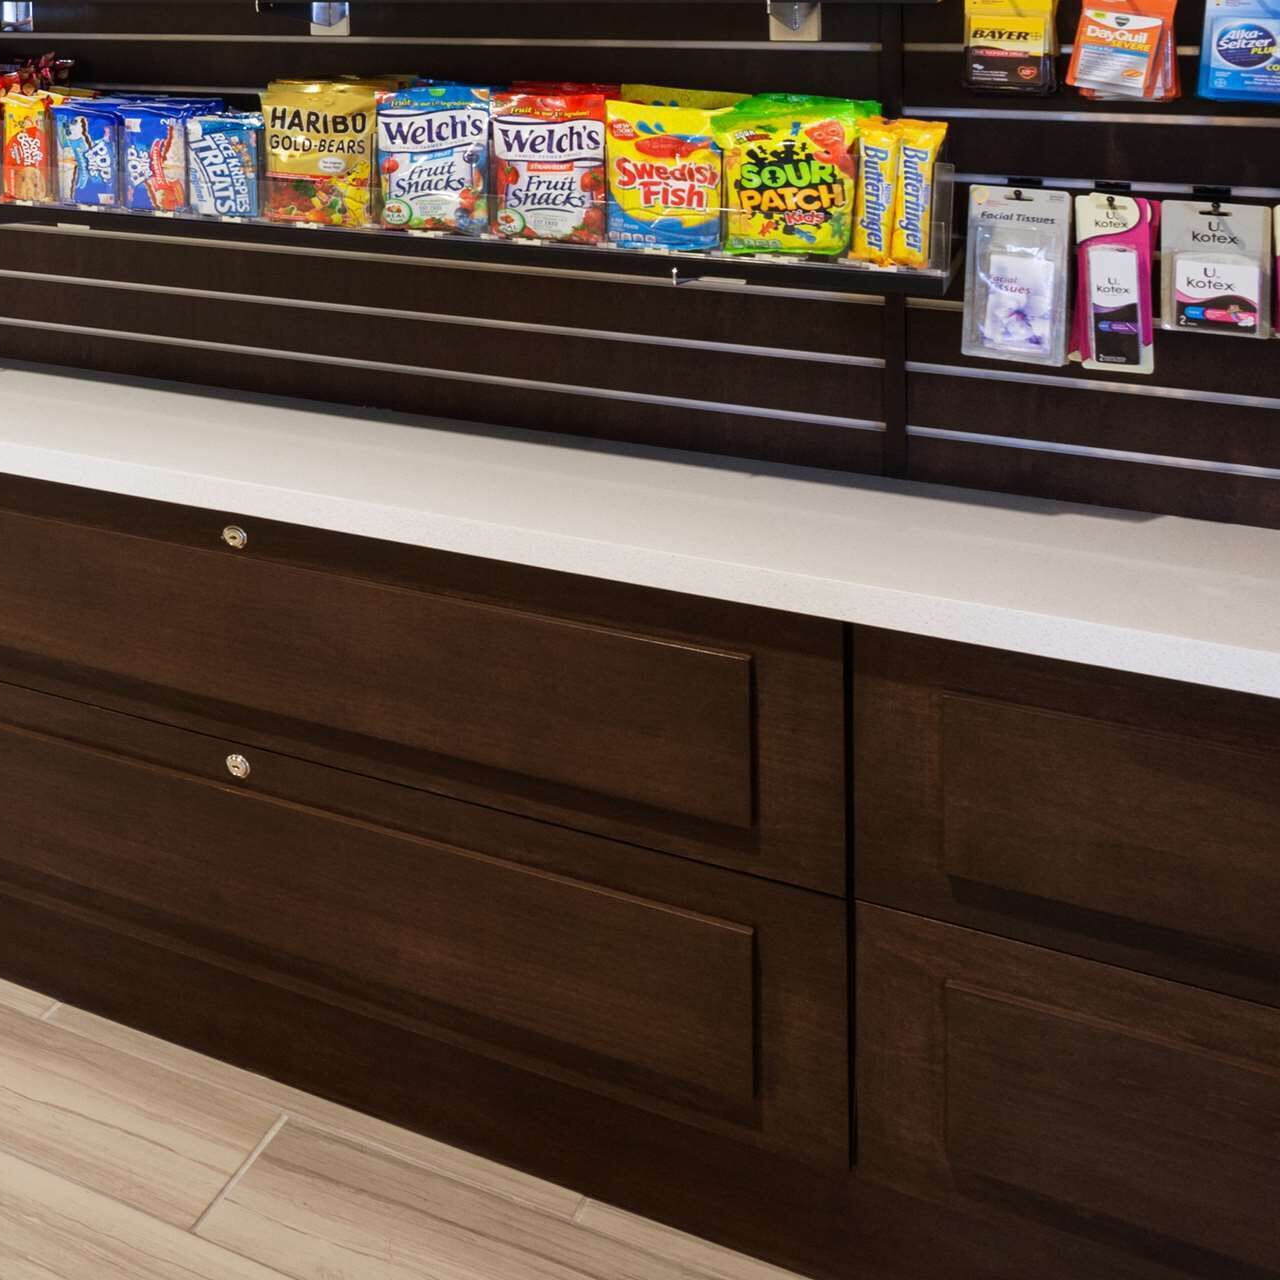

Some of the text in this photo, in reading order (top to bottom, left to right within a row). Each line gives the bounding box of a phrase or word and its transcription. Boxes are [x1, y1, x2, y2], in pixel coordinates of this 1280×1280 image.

[971, 30, 1029, 42] BAYER
[1086, 25, 1147, 43] DayQuil
[1224, 29, 1264, 41] Alka-
[1110, 40, 1151, 52] SEVERE
[1218, 38, 1270, 51] Seltzer
[271, 107, 367, 135] HARIBO
[382, 115, 483, 145] Welch's
[270, 134, 366, 154] GOLD-BEARS
[498, 126, 600, 154] Welch's
[198, 137, 236, 214] TREATS
[211, 134, 250, 212] RICE KRISPIES
[409, 161, 456, 181] Fruit
[742, 163, 835, 188] SOUR
[395, 175, 466, 198] Snacks
[525, 175, 576, 192] Fruit
[509, 188, 586, 208] Snacks
[642, 182, 705, 208] Fish
[741, 183, 845, 212] PATCH
[859, 146, 889, 251] Butterfinger
[898, 146, 929, 252] Butterfinger
[784, 210, 824, 225] Kids
[980, 211, 1056, 225] Facial Tissues
[1094, 219, 1128, 229] kotex
[1191, 230, 1238, 245] kotex
[1096, 285, 1130, 295] kotex
[1186, 276, 1235, 291] kotex
[1179, 315, 1186, 326] 2
